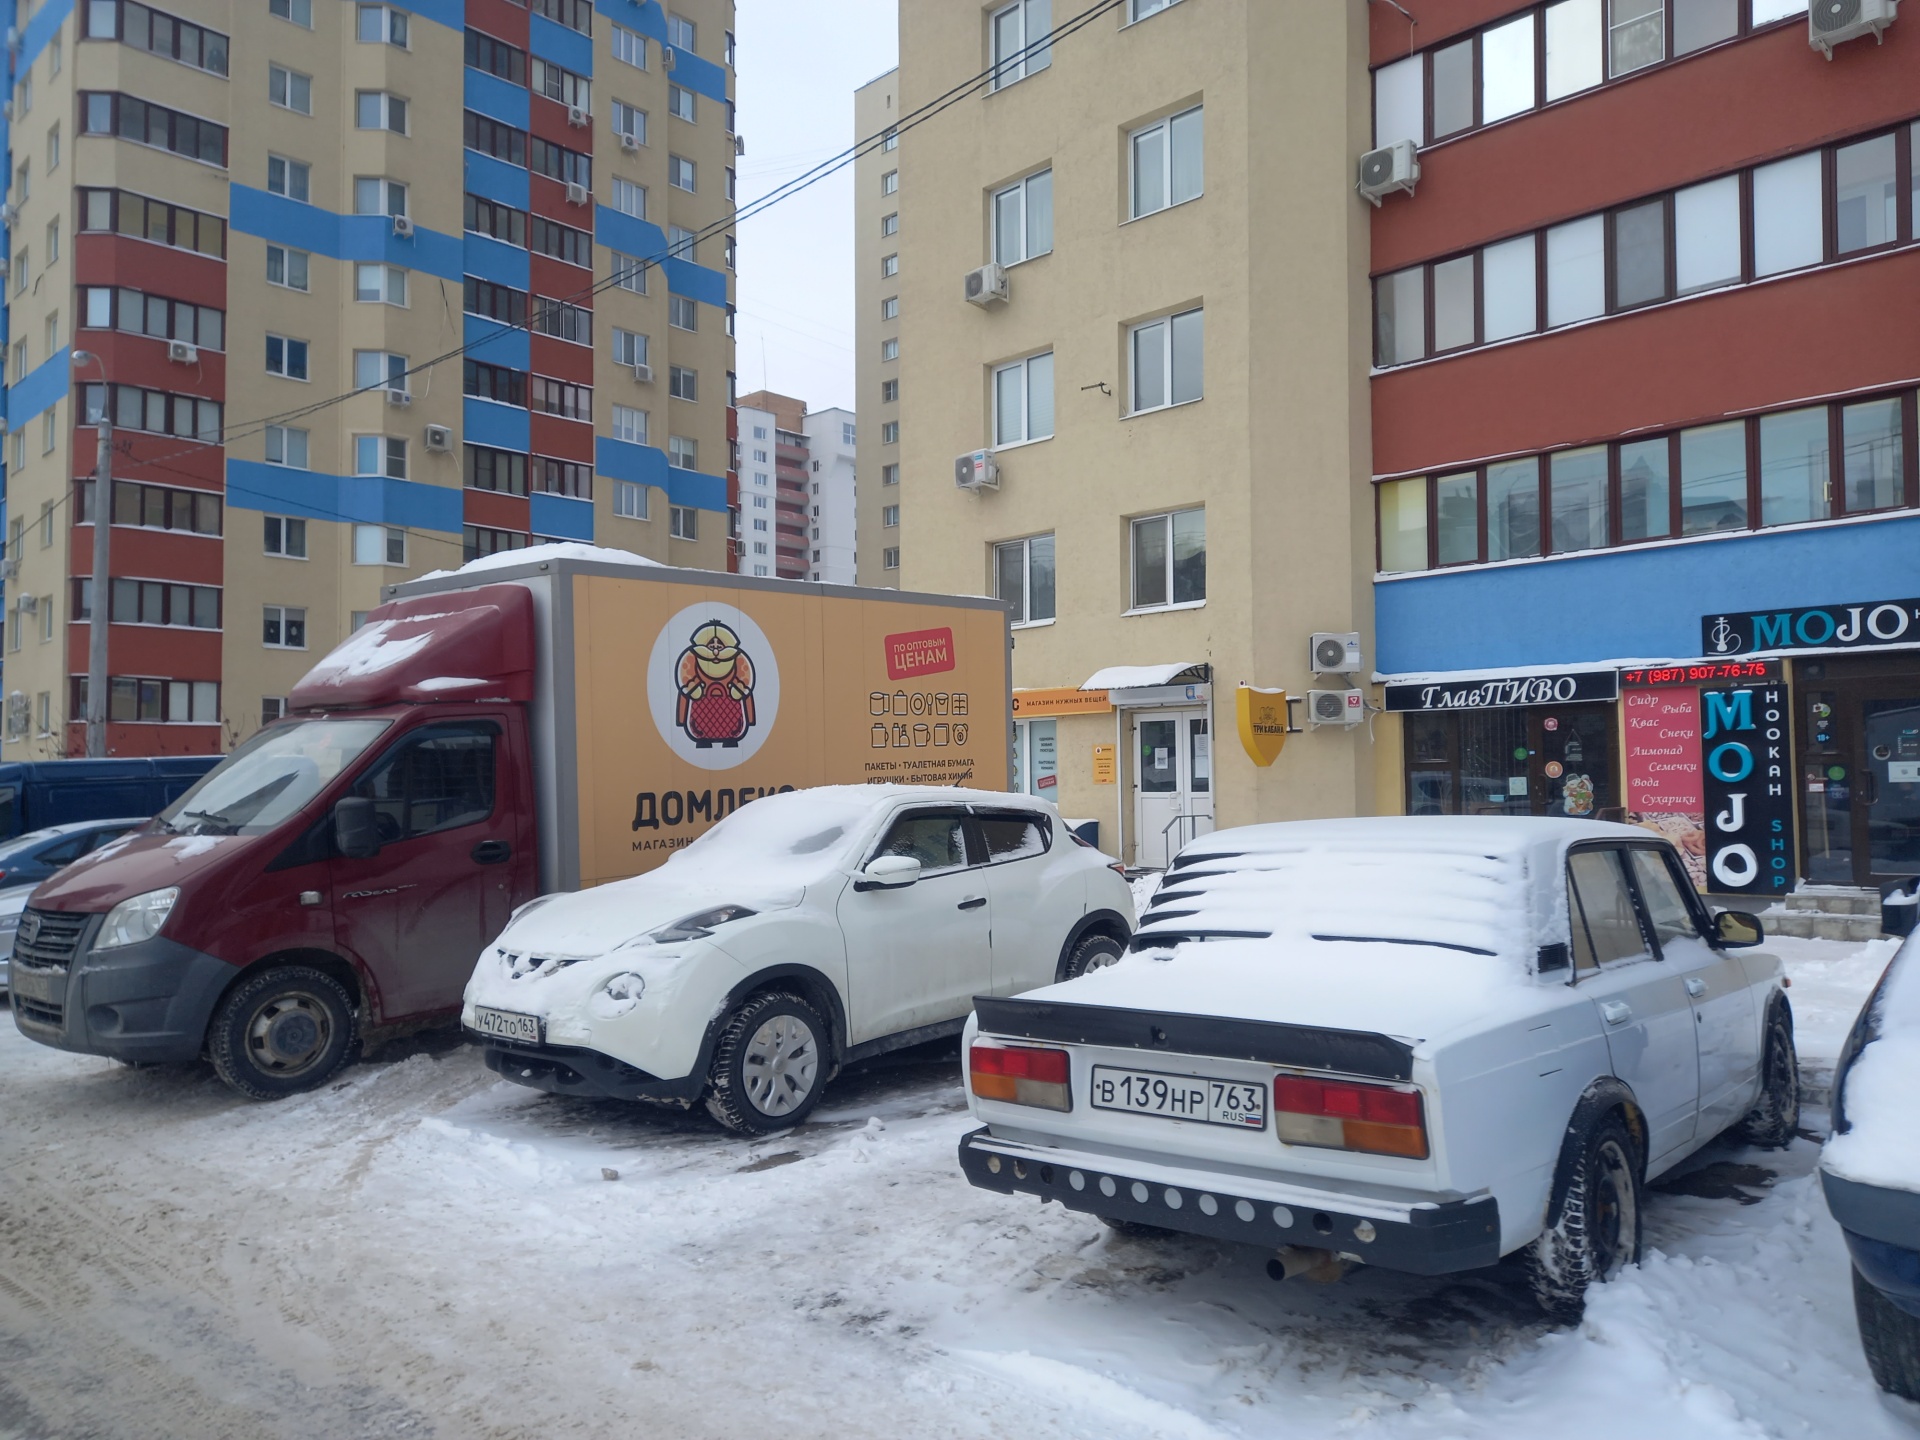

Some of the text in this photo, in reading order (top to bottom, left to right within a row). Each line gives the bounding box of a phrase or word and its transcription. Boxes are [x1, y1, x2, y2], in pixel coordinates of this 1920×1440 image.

[1750, 604, 1909, 652] MOJO
[893, 637, 946, 653] ПО ОПТОВЫМ
[894, 647, 948, 672] ЦЕНАМ
[1626, 663, 1766, 684] +7 (987) 907-76-75
[1421, 677, 1577, 709] ГлавПИВО
[1026, 699, 1054, 707] МАГАЗИН
[1055, 697, 1083, 705] НУЖНЫХ
[1084, 695, 1107, 703] ВЕЩЕЙ
[1628, 694, 1659, 708] Сидр
[1661, 703, 1692, 714] Рыба
[1253, 724, 1285, 734] ТРИ КАБАНА
[1630, 717, 1660, 729] Квас
[1659, 729, 1694, 740] Снеки
[1630, 745, 1683, 757] Лимонад
[864, 758, 975, 771] ПАКЕТЫ ТУАЛЕТНАЯ БУМАГА
[1648, 762, 1697, 773] Семечки
[867, 771, 973, 785] ИГРУШКИ БЫТОВАЯ ХИМИЯ
[1632, 776, 1660, 787] Вода
[1702, 689, 1758, 888] MOJO
[1765, 691, 1787, 888] HOOKAH SHOP
[1641, 794, 1697, 807] Сухарики
[632, 836, 694, 852] МАГАЗИН
[1212, 1083, 1257, 1113] 763
[1222, 1110, 1245, 1122] RUS
